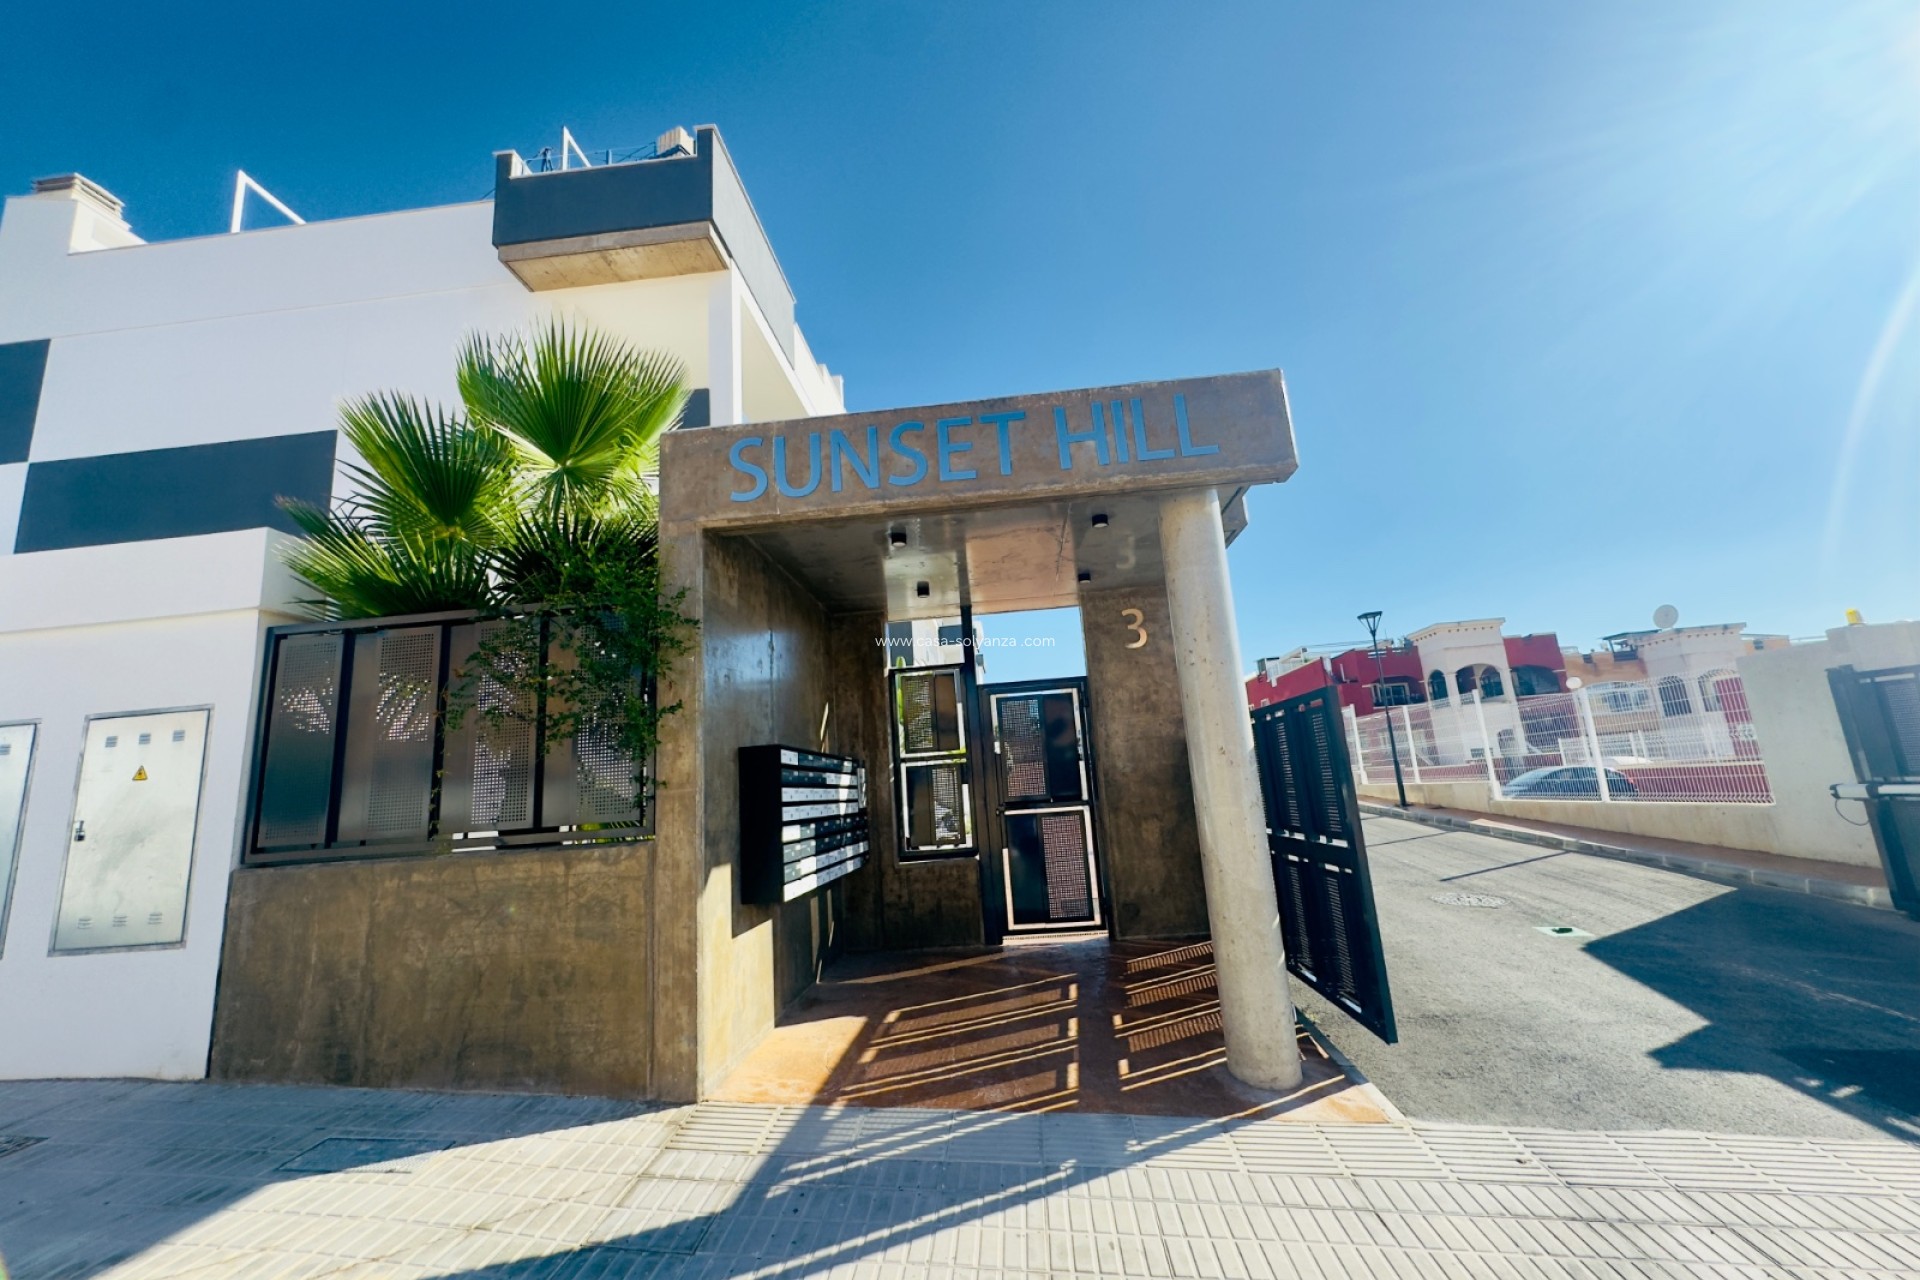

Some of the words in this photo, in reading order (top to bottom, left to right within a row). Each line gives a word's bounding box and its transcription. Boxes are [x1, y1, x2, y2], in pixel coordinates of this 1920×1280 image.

[729, 410, 1026, 502] SUNSET
[1053, 393, 1219, 470] HILL
[1121, 608, 1148, 649] 3
